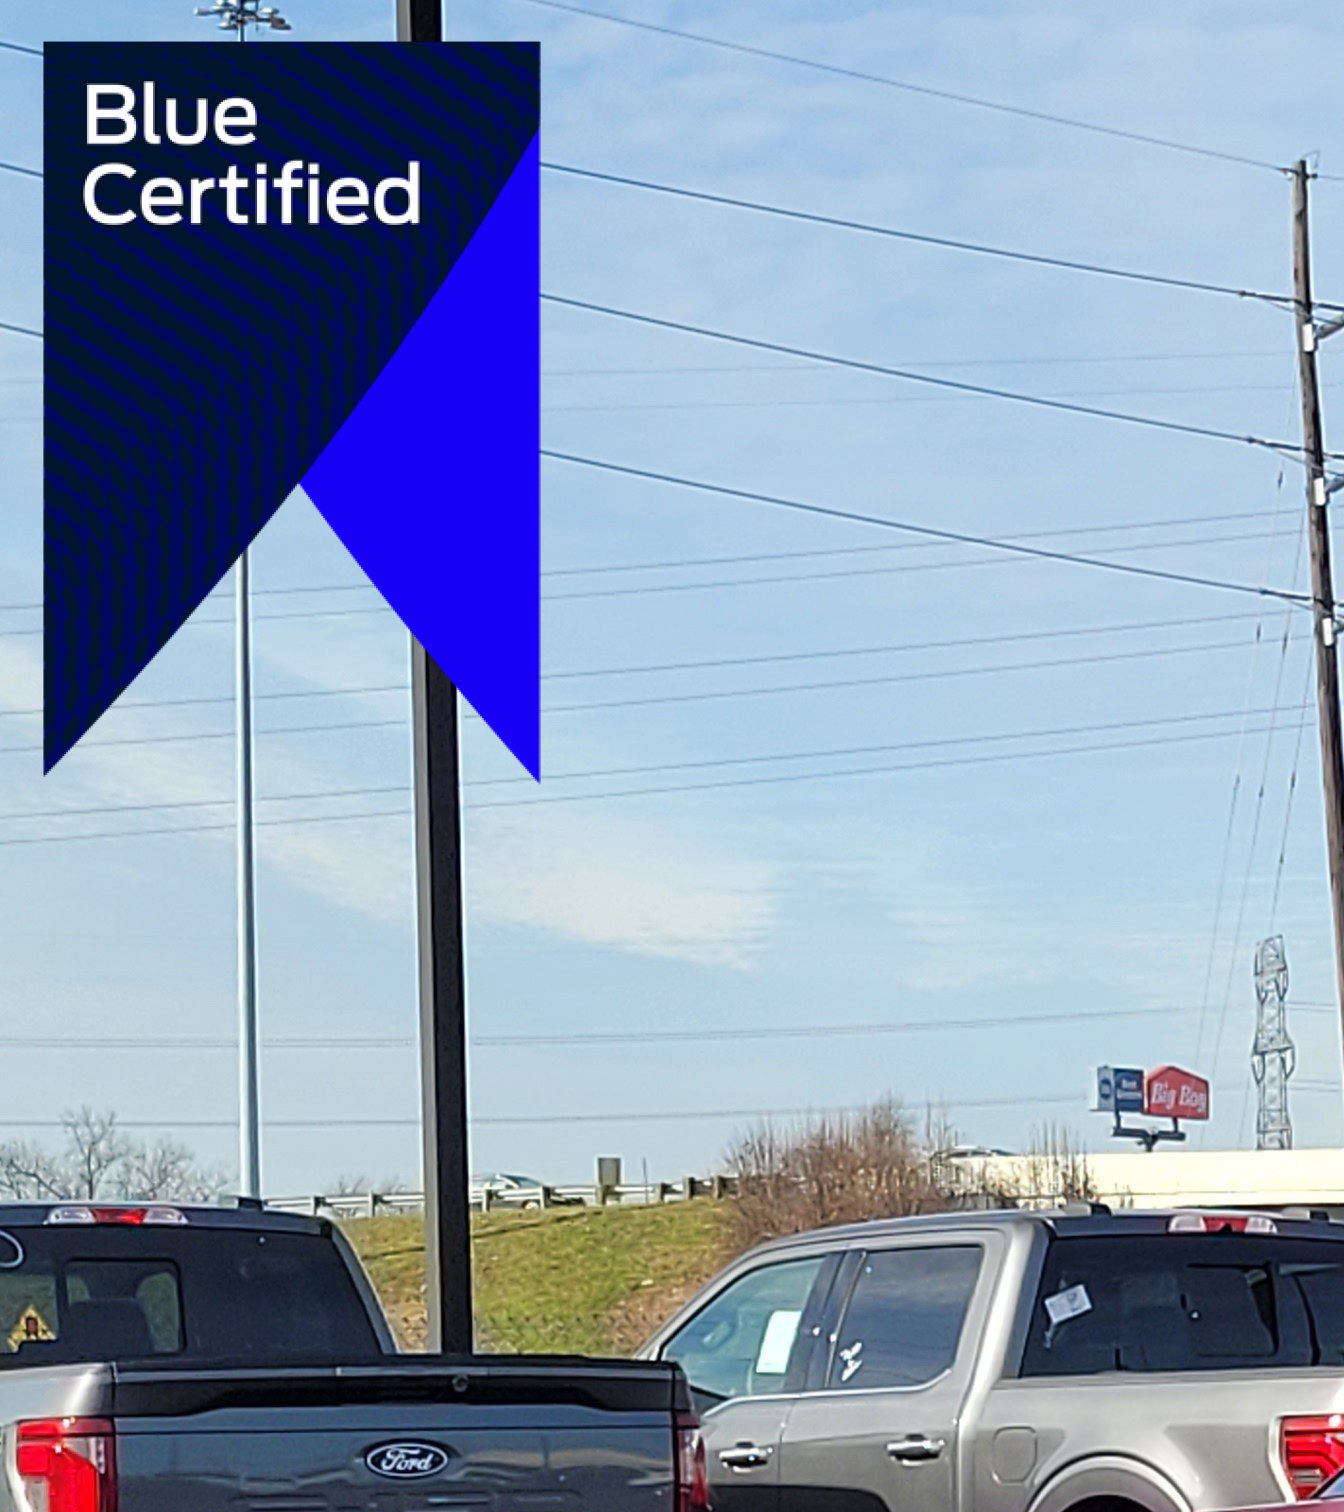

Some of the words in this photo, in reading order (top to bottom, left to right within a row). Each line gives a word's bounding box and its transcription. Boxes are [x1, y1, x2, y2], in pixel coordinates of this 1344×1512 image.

[1152, 1083, 1176, 1110] Big
[1180, 1084, 1206, 1112] Boy
[381, 1447, 434, 1471] Ford
